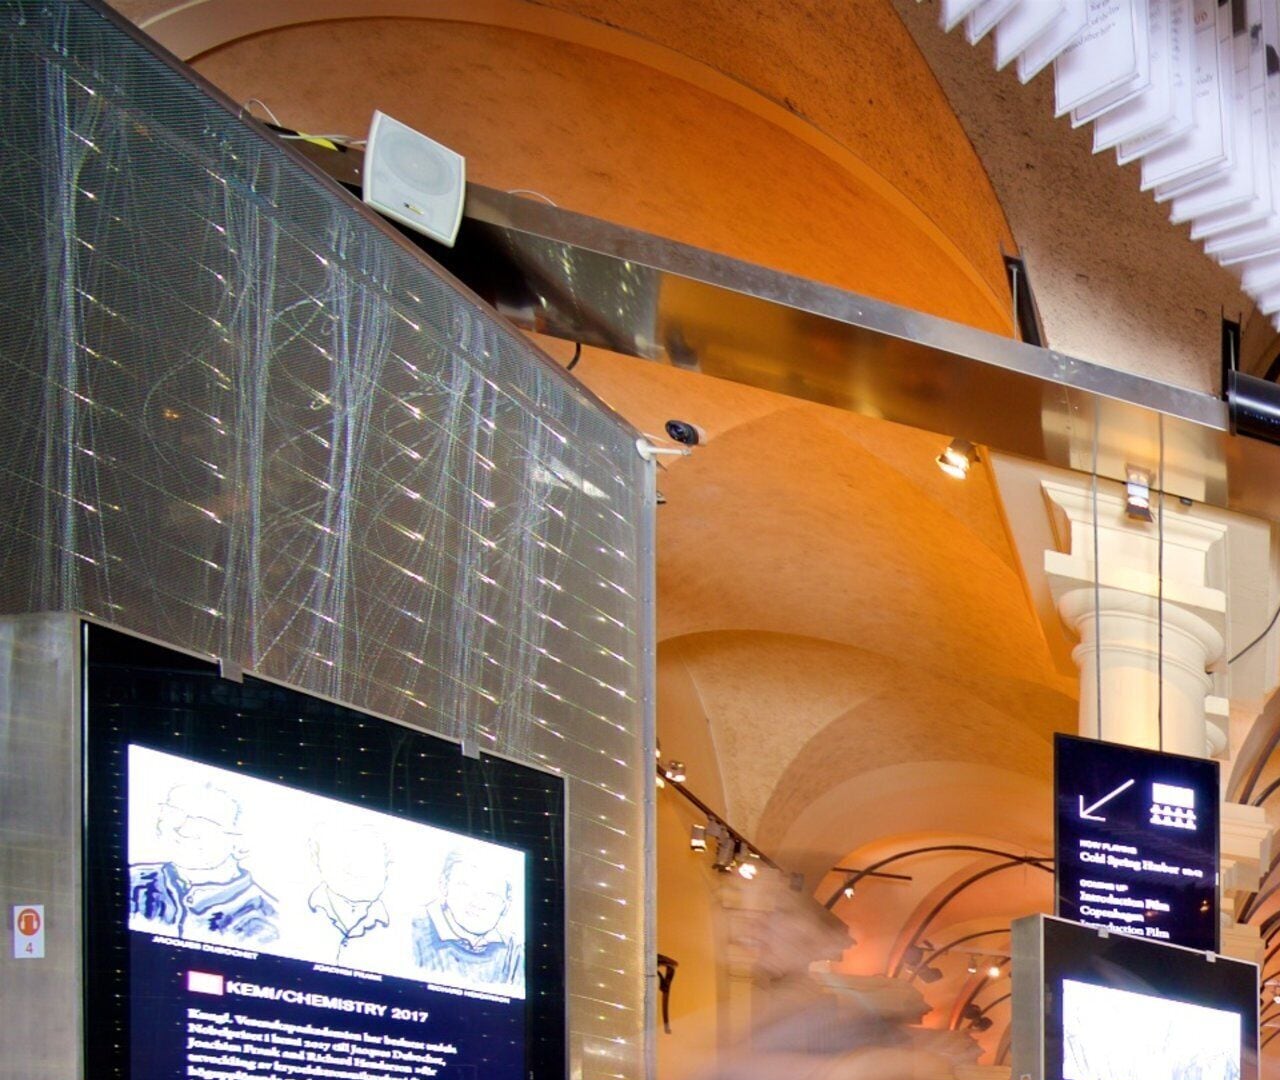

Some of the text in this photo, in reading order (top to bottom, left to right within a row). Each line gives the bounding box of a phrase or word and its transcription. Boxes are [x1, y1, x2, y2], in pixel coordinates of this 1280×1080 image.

[1079, 851, 1106, 865] Cold
[1106, 854, 1141, 872] Spring
[1141, 859, 1180, 875] Harbor
[1115, 883, 1129, 892] UP
[1079, 890, 1171, 912] Introduction Film
[1079, 905, 1145, 923] Copenhagen
[1145, 926, 1170, 939] Film
[226, 981, 430, 1024] KEMI/CHEMISTRY 2017
[186, 1036, 242, 1053] Joachim
[243, 1043, 281, 1057] Frank
[306, 1051, 353, 1066] Richard
[303, 1040, 331, 1052] 2017
